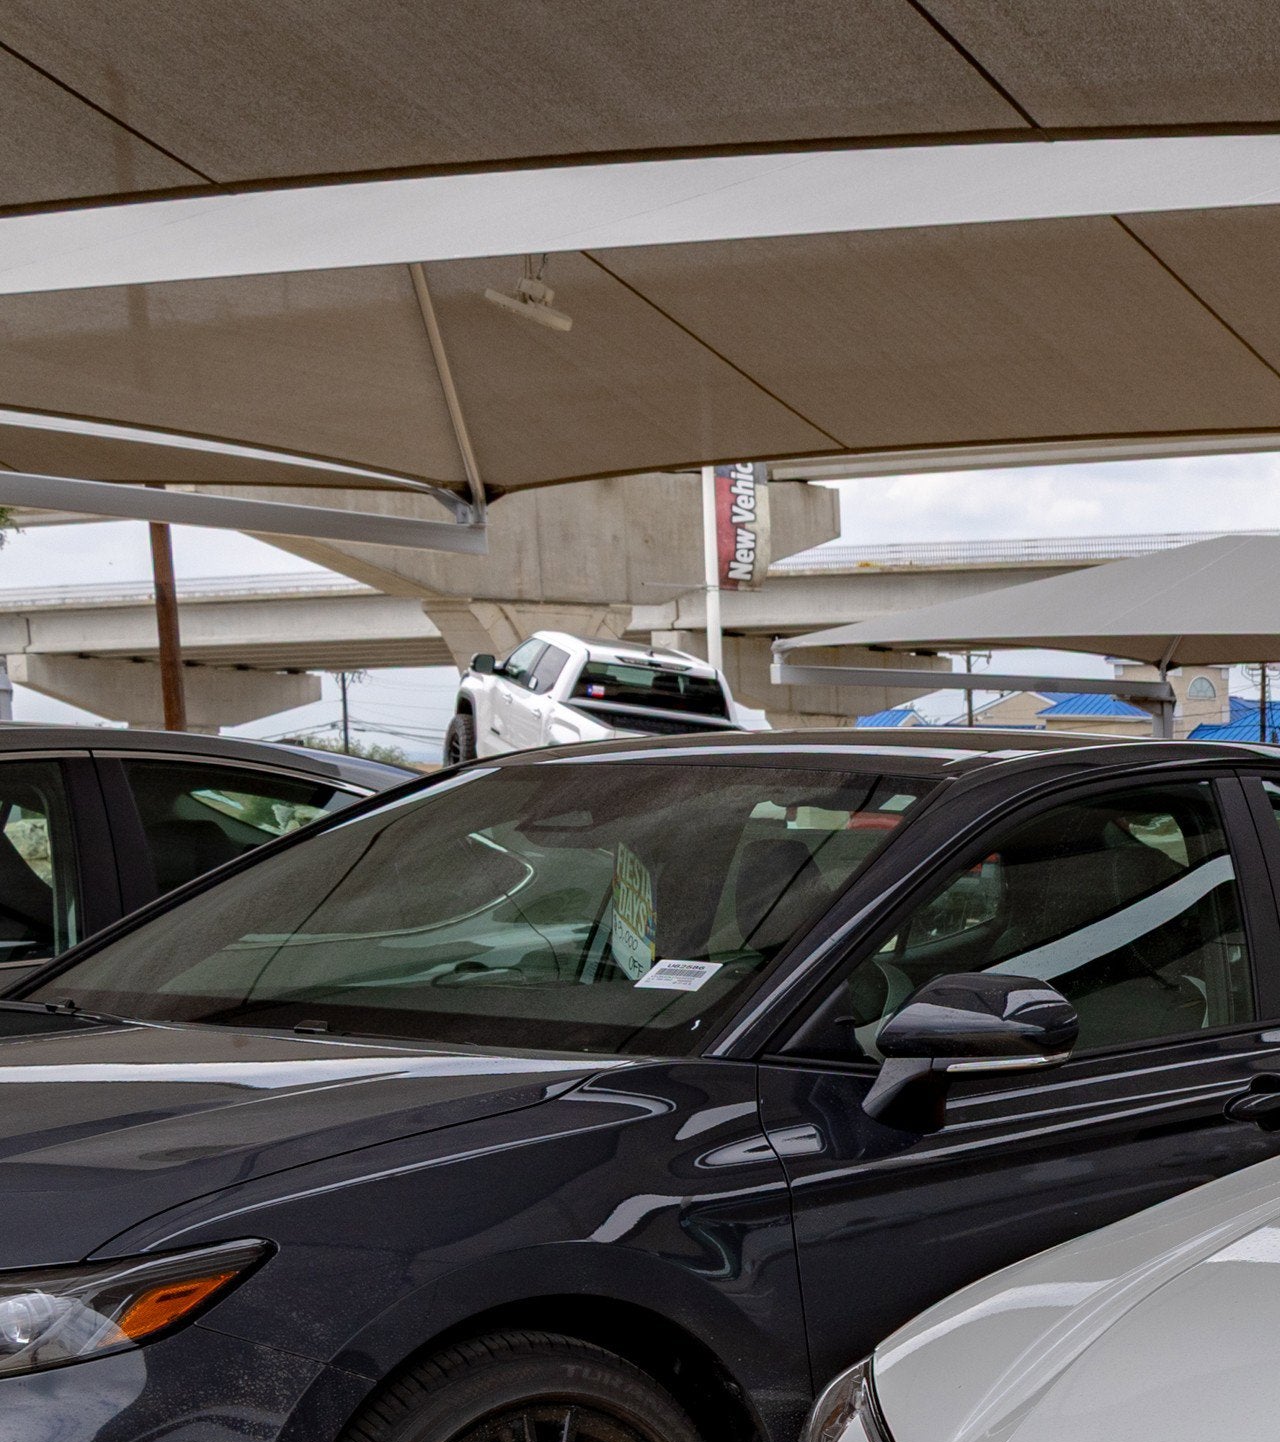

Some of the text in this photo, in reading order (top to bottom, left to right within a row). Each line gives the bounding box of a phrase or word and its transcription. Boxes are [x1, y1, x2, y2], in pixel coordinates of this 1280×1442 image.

[728, 528, 757, 581] New
[617, 841, 653, 912] FIESTA
[619, 880, 648, 939] DAYS
[628, 955, 644, 978] OFF
